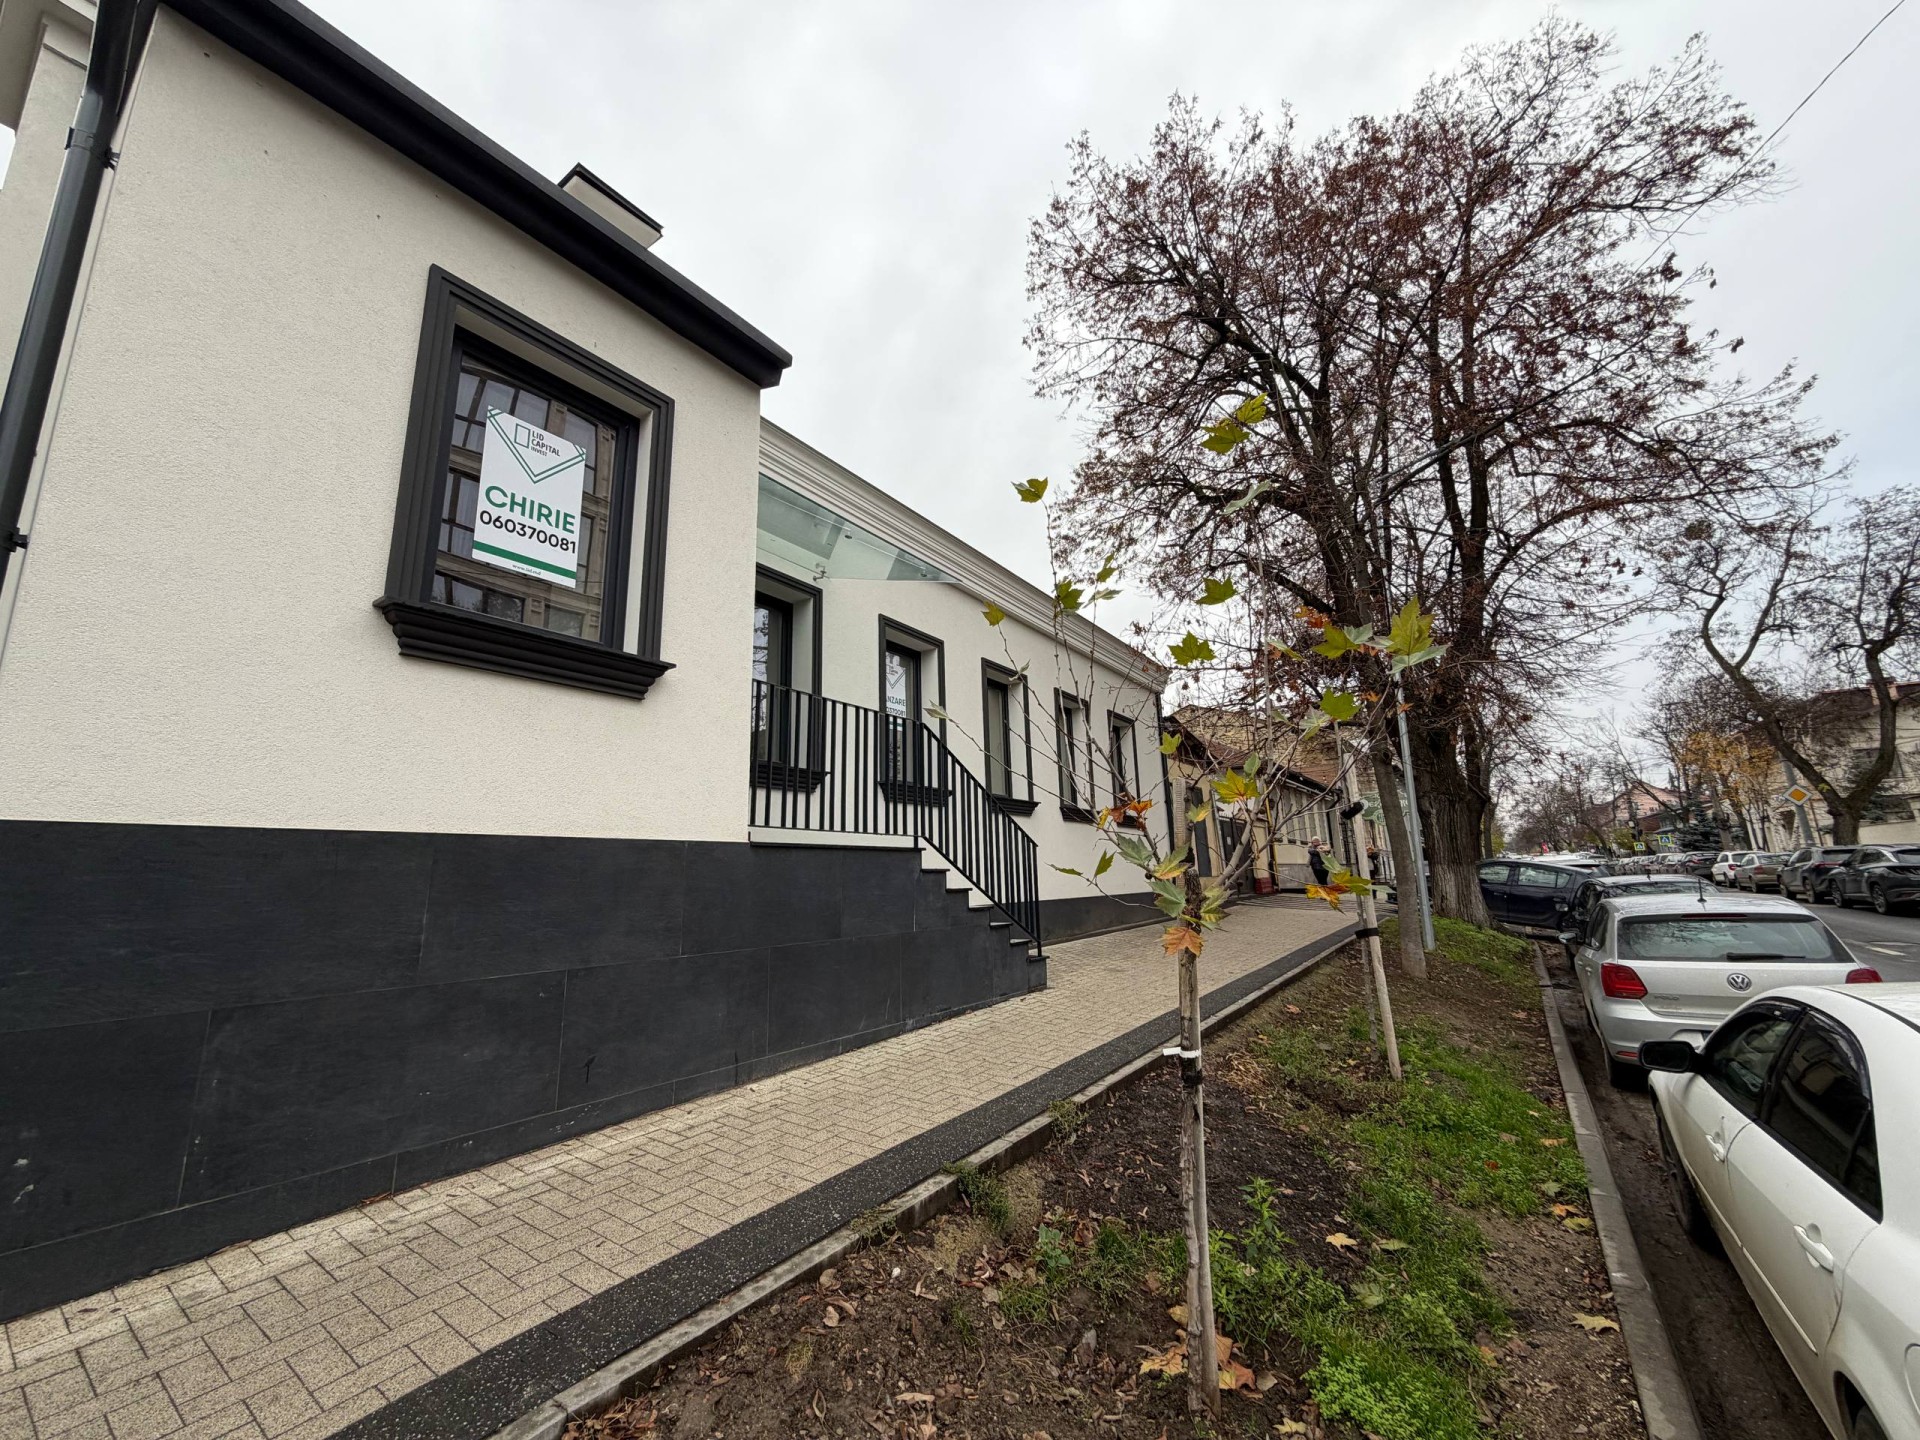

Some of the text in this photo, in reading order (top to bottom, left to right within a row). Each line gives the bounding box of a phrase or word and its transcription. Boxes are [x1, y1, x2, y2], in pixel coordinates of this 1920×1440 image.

[531, 430, 545, 441] LID
[530, 446, 548, 457] INVEST
[531, 438, 561, 457] CAPITAL
[485, 485, 576, 534] CHIRIE
[479, 510, 577, 554] 060370081
